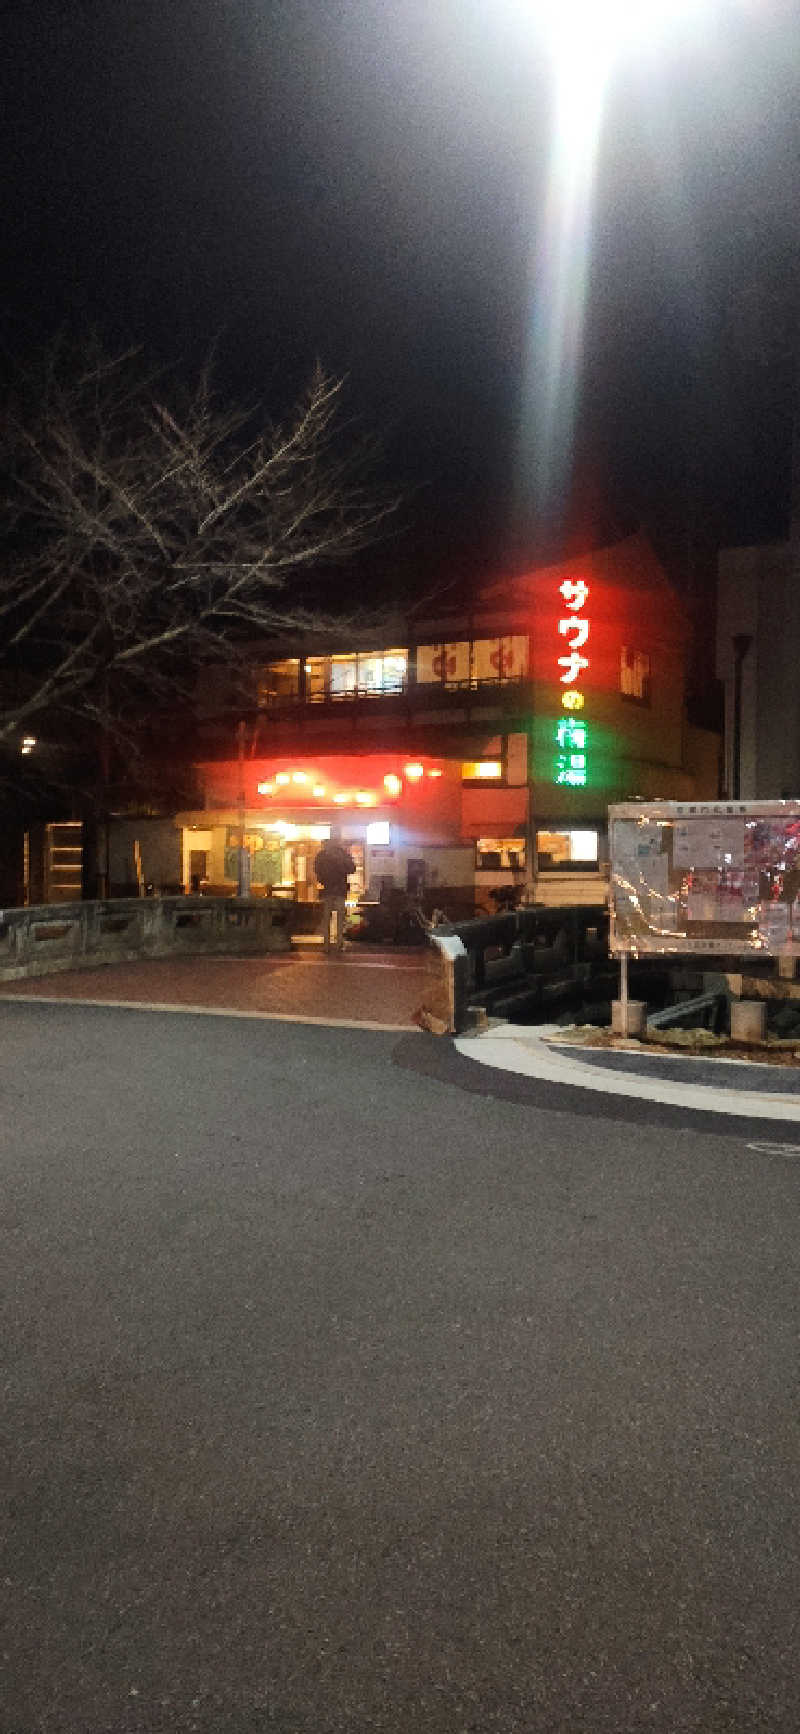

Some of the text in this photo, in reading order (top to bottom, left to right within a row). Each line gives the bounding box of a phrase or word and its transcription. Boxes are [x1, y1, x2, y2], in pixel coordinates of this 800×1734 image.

[555, 579, 589, 786] サウナの梅湯
